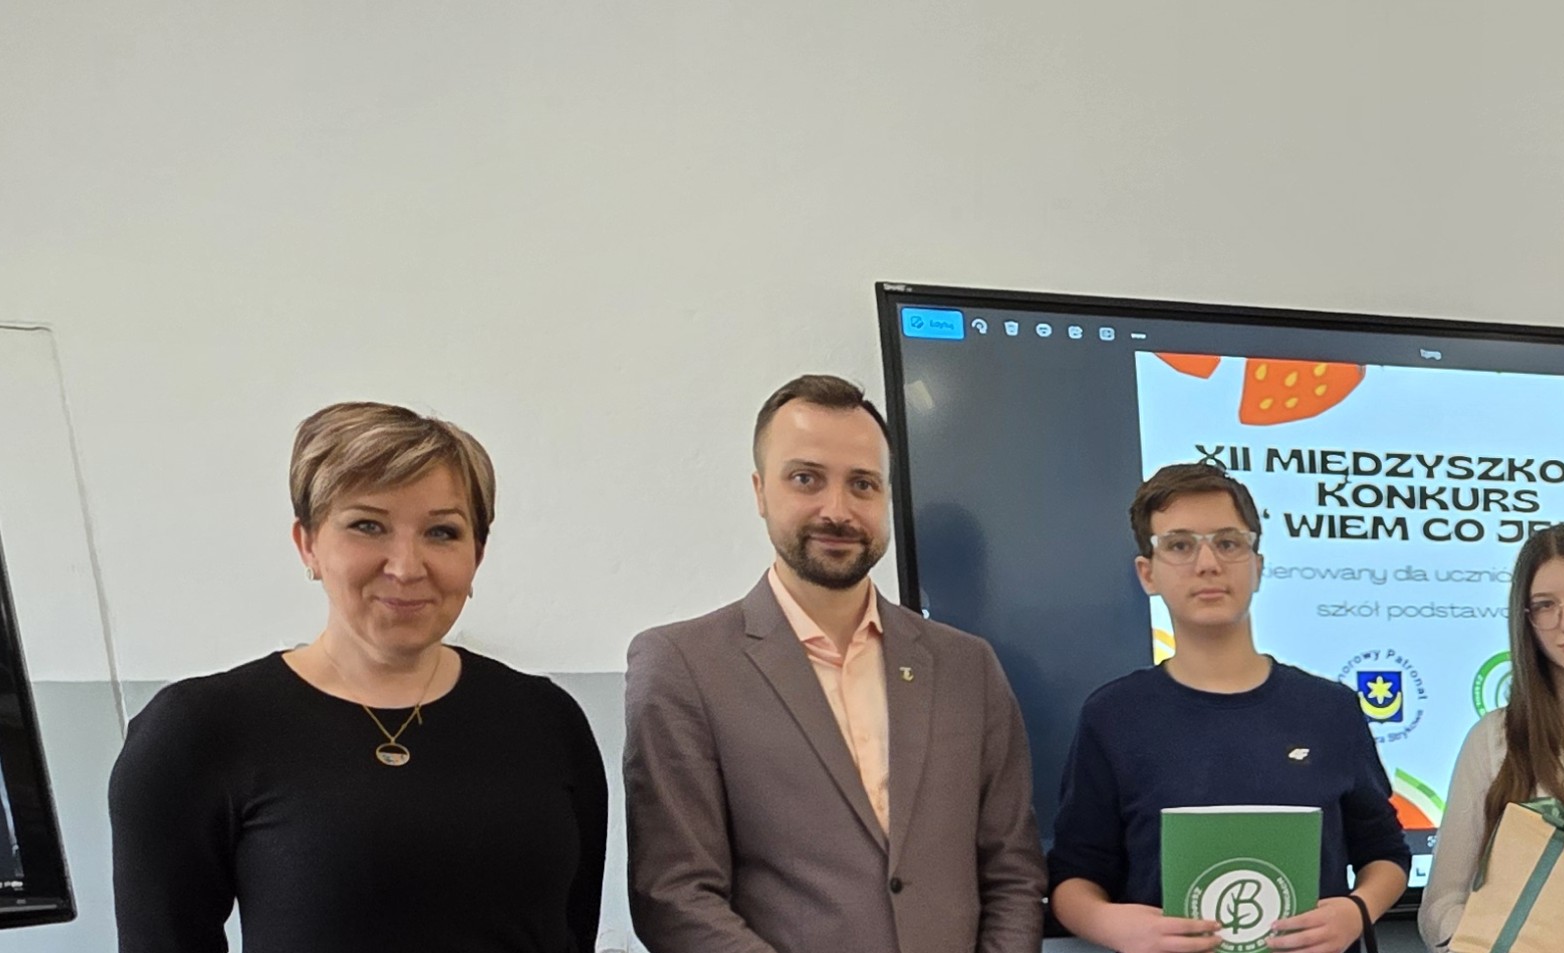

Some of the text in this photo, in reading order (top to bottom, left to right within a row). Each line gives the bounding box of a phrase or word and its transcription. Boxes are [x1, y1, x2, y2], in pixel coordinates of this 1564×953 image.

[1195, 444, 1251, 471] XII
[1317, 482, 1541, 513] KONKURS
[1284, 512, 1409, 541] WIEM
[1422, 517, 1485, 542] CO
[1435, 567, 1513, 584] ucznió
[1317, 601, 1508, 620] szkół podstawo
